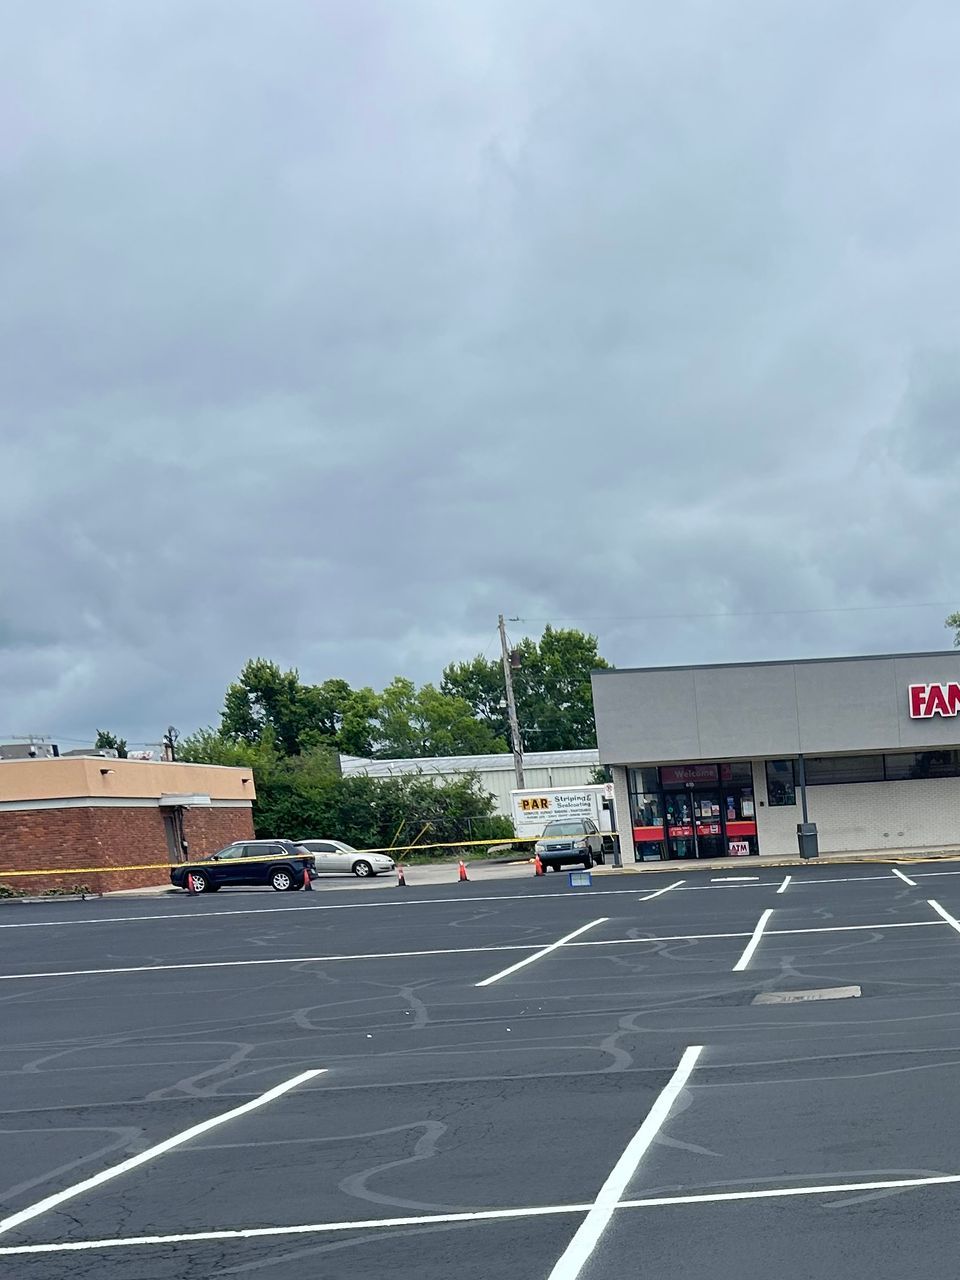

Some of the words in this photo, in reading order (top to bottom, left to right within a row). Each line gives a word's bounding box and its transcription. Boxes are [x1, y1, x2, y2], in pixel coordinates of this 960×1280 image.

[674, 769, 714, 778] Welcome
[554, 795, 586, 803] Striping
[522, 798, 549, 810] PAR
[732, 844, 748, 852] ATM
